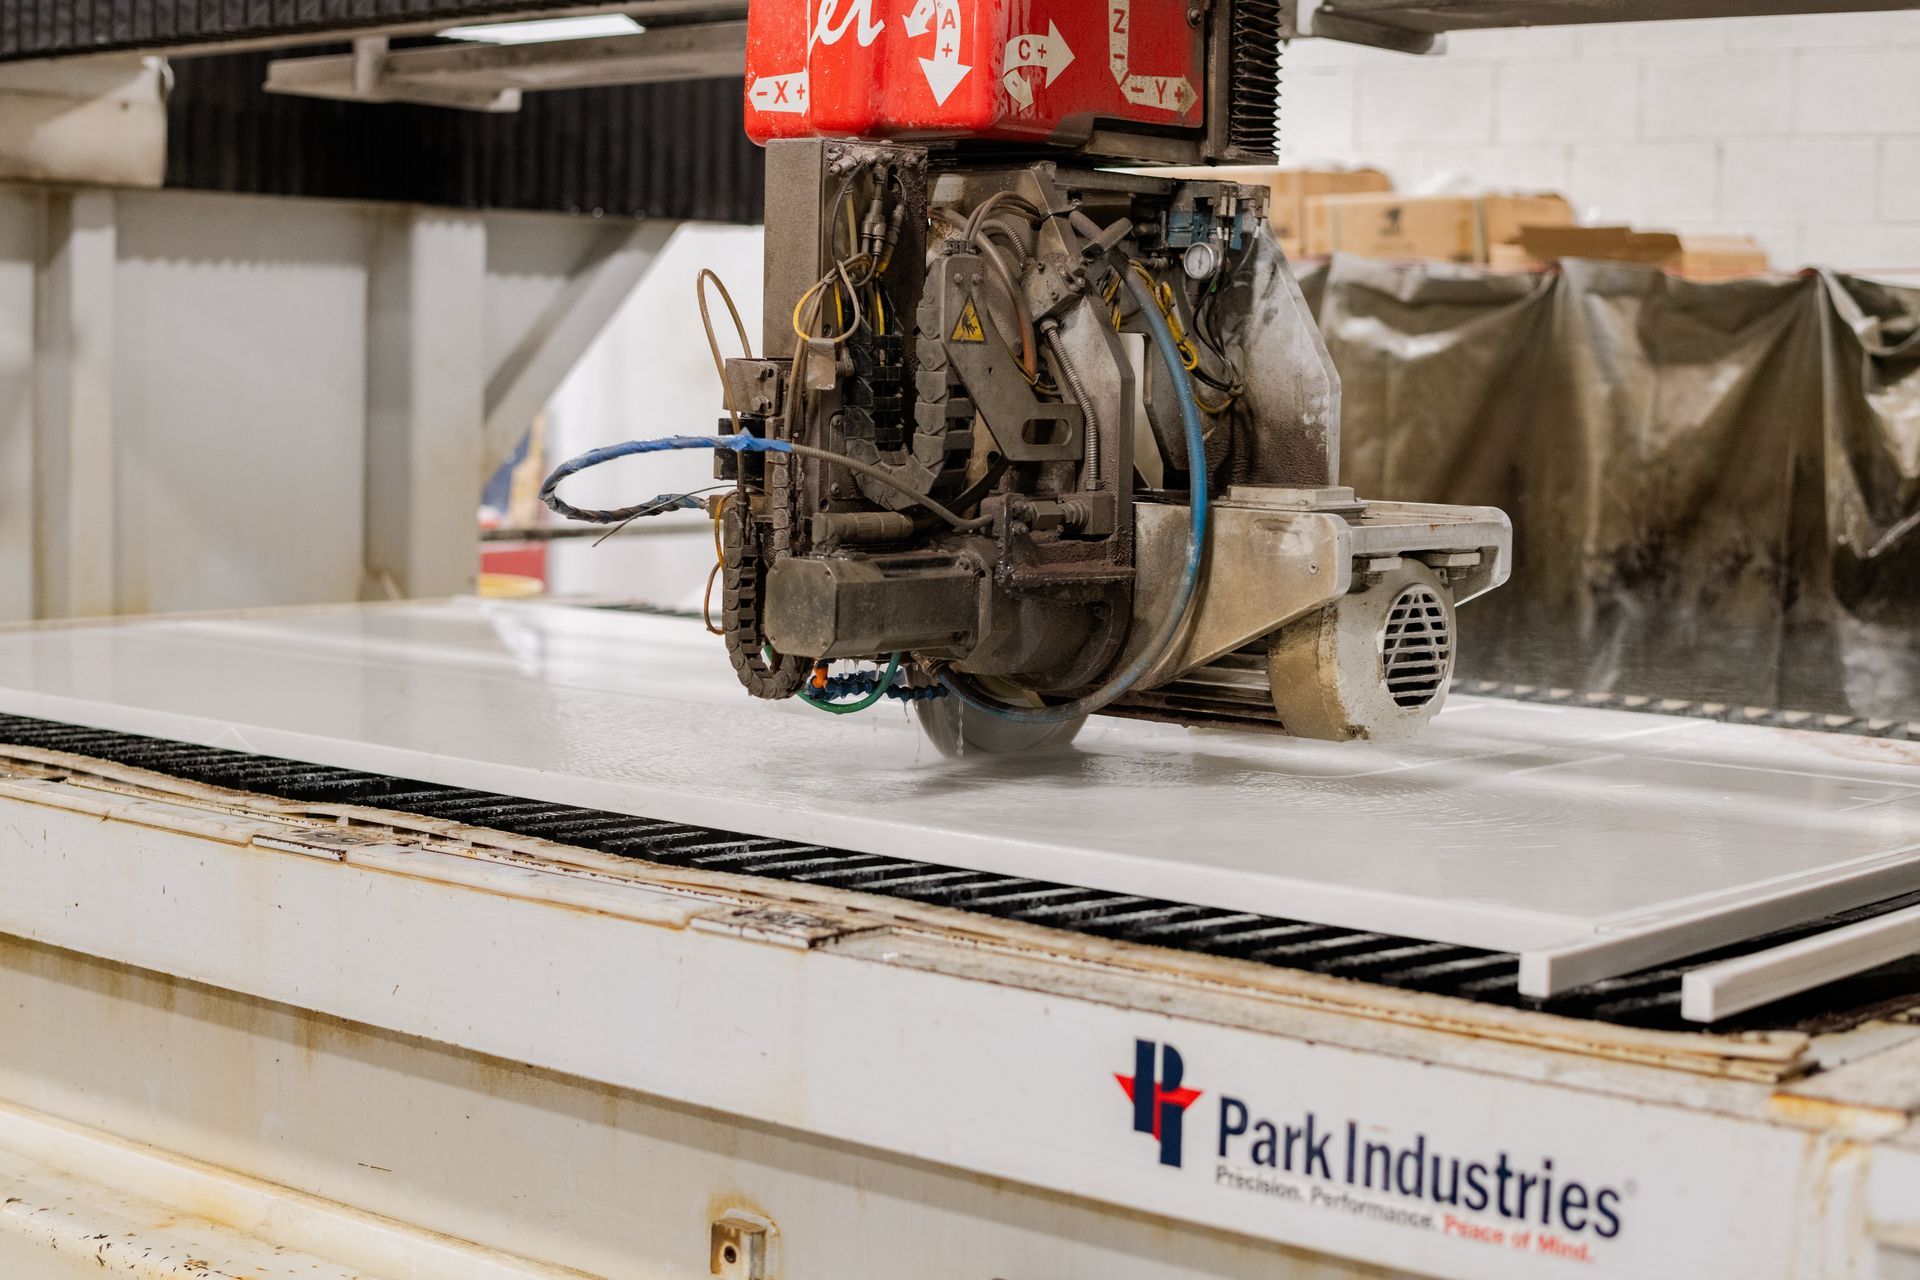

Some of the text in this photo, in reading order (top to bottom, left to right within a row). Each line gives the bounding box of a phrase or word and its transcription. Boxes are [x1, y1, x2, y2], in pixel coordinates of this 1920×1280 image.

[1218, 1095, 1621, 1239] Park Industries
[1442, 1213, 1505, 1245] Peace
[1512, 1229, 1532, 1249] of
